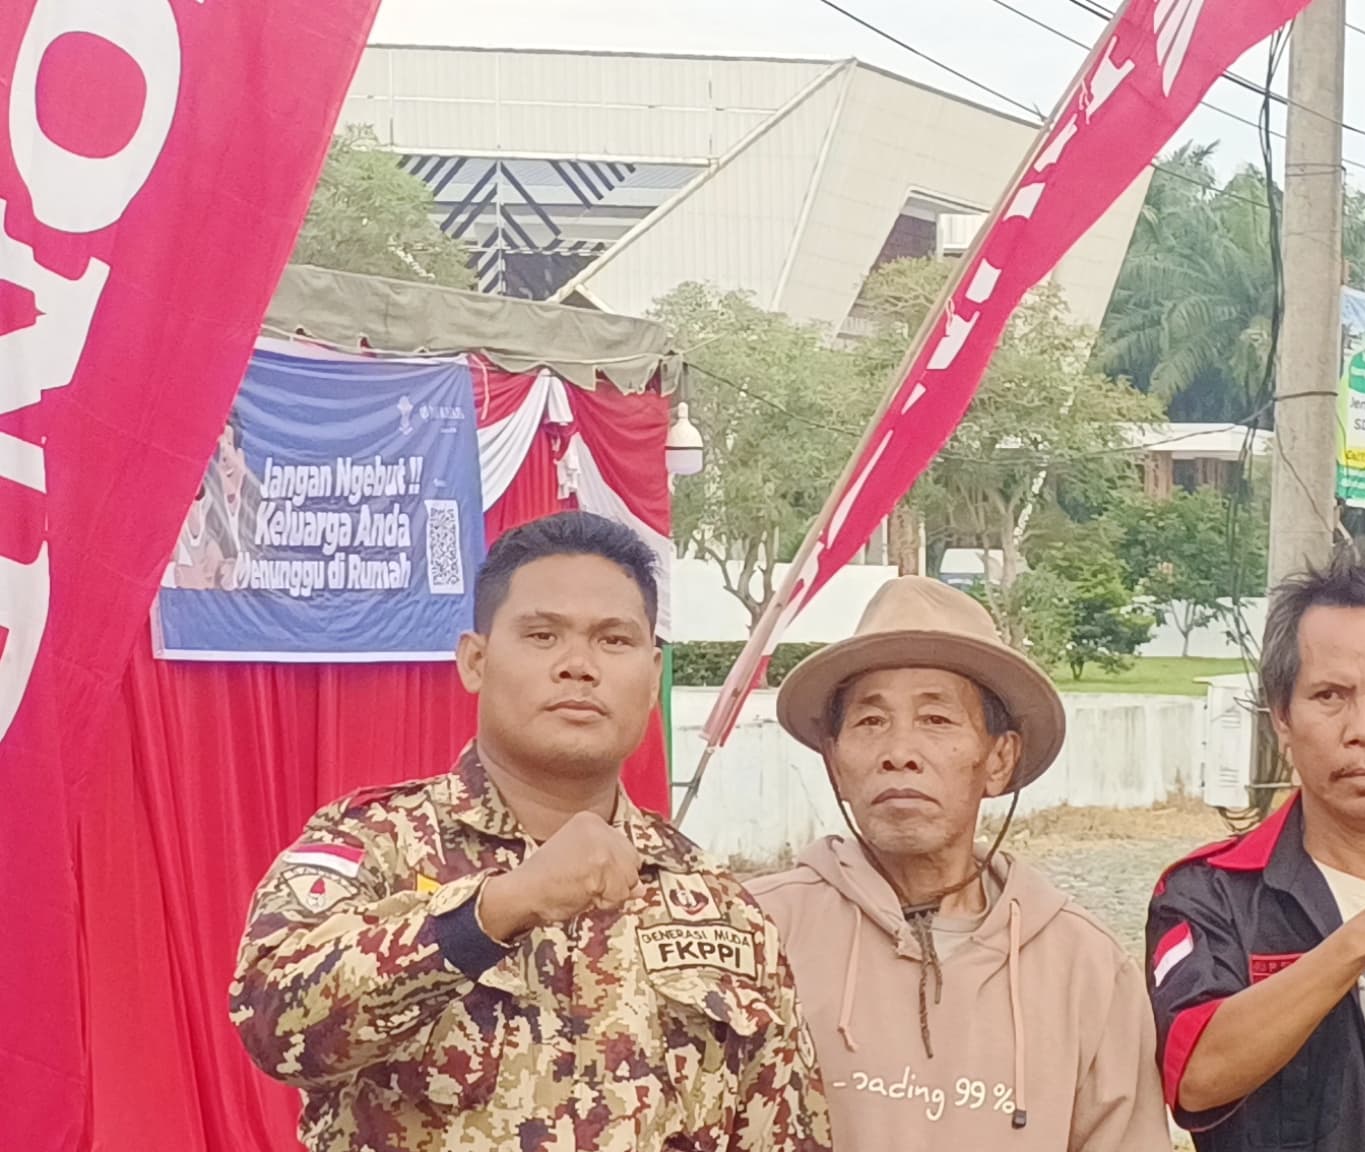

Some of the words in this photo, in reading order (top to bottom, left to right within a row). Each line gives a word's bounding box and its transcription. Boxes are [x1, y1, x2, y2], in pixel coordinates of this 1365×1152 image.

[260, 456, 333, 506] Jangan
[335, 455, 406, 505] Ngebut
[254, 500, 352, 555] Keluarga
[354, 503, 411, 548] Anda
[233, 551, 324, 597] Menunggu
[327, 552, 345, 589] di
[347, 552, 411, 590] Rumah
[659, 941, 740, 969] FKPPI
[832, 1065, 946, 1121] oading
